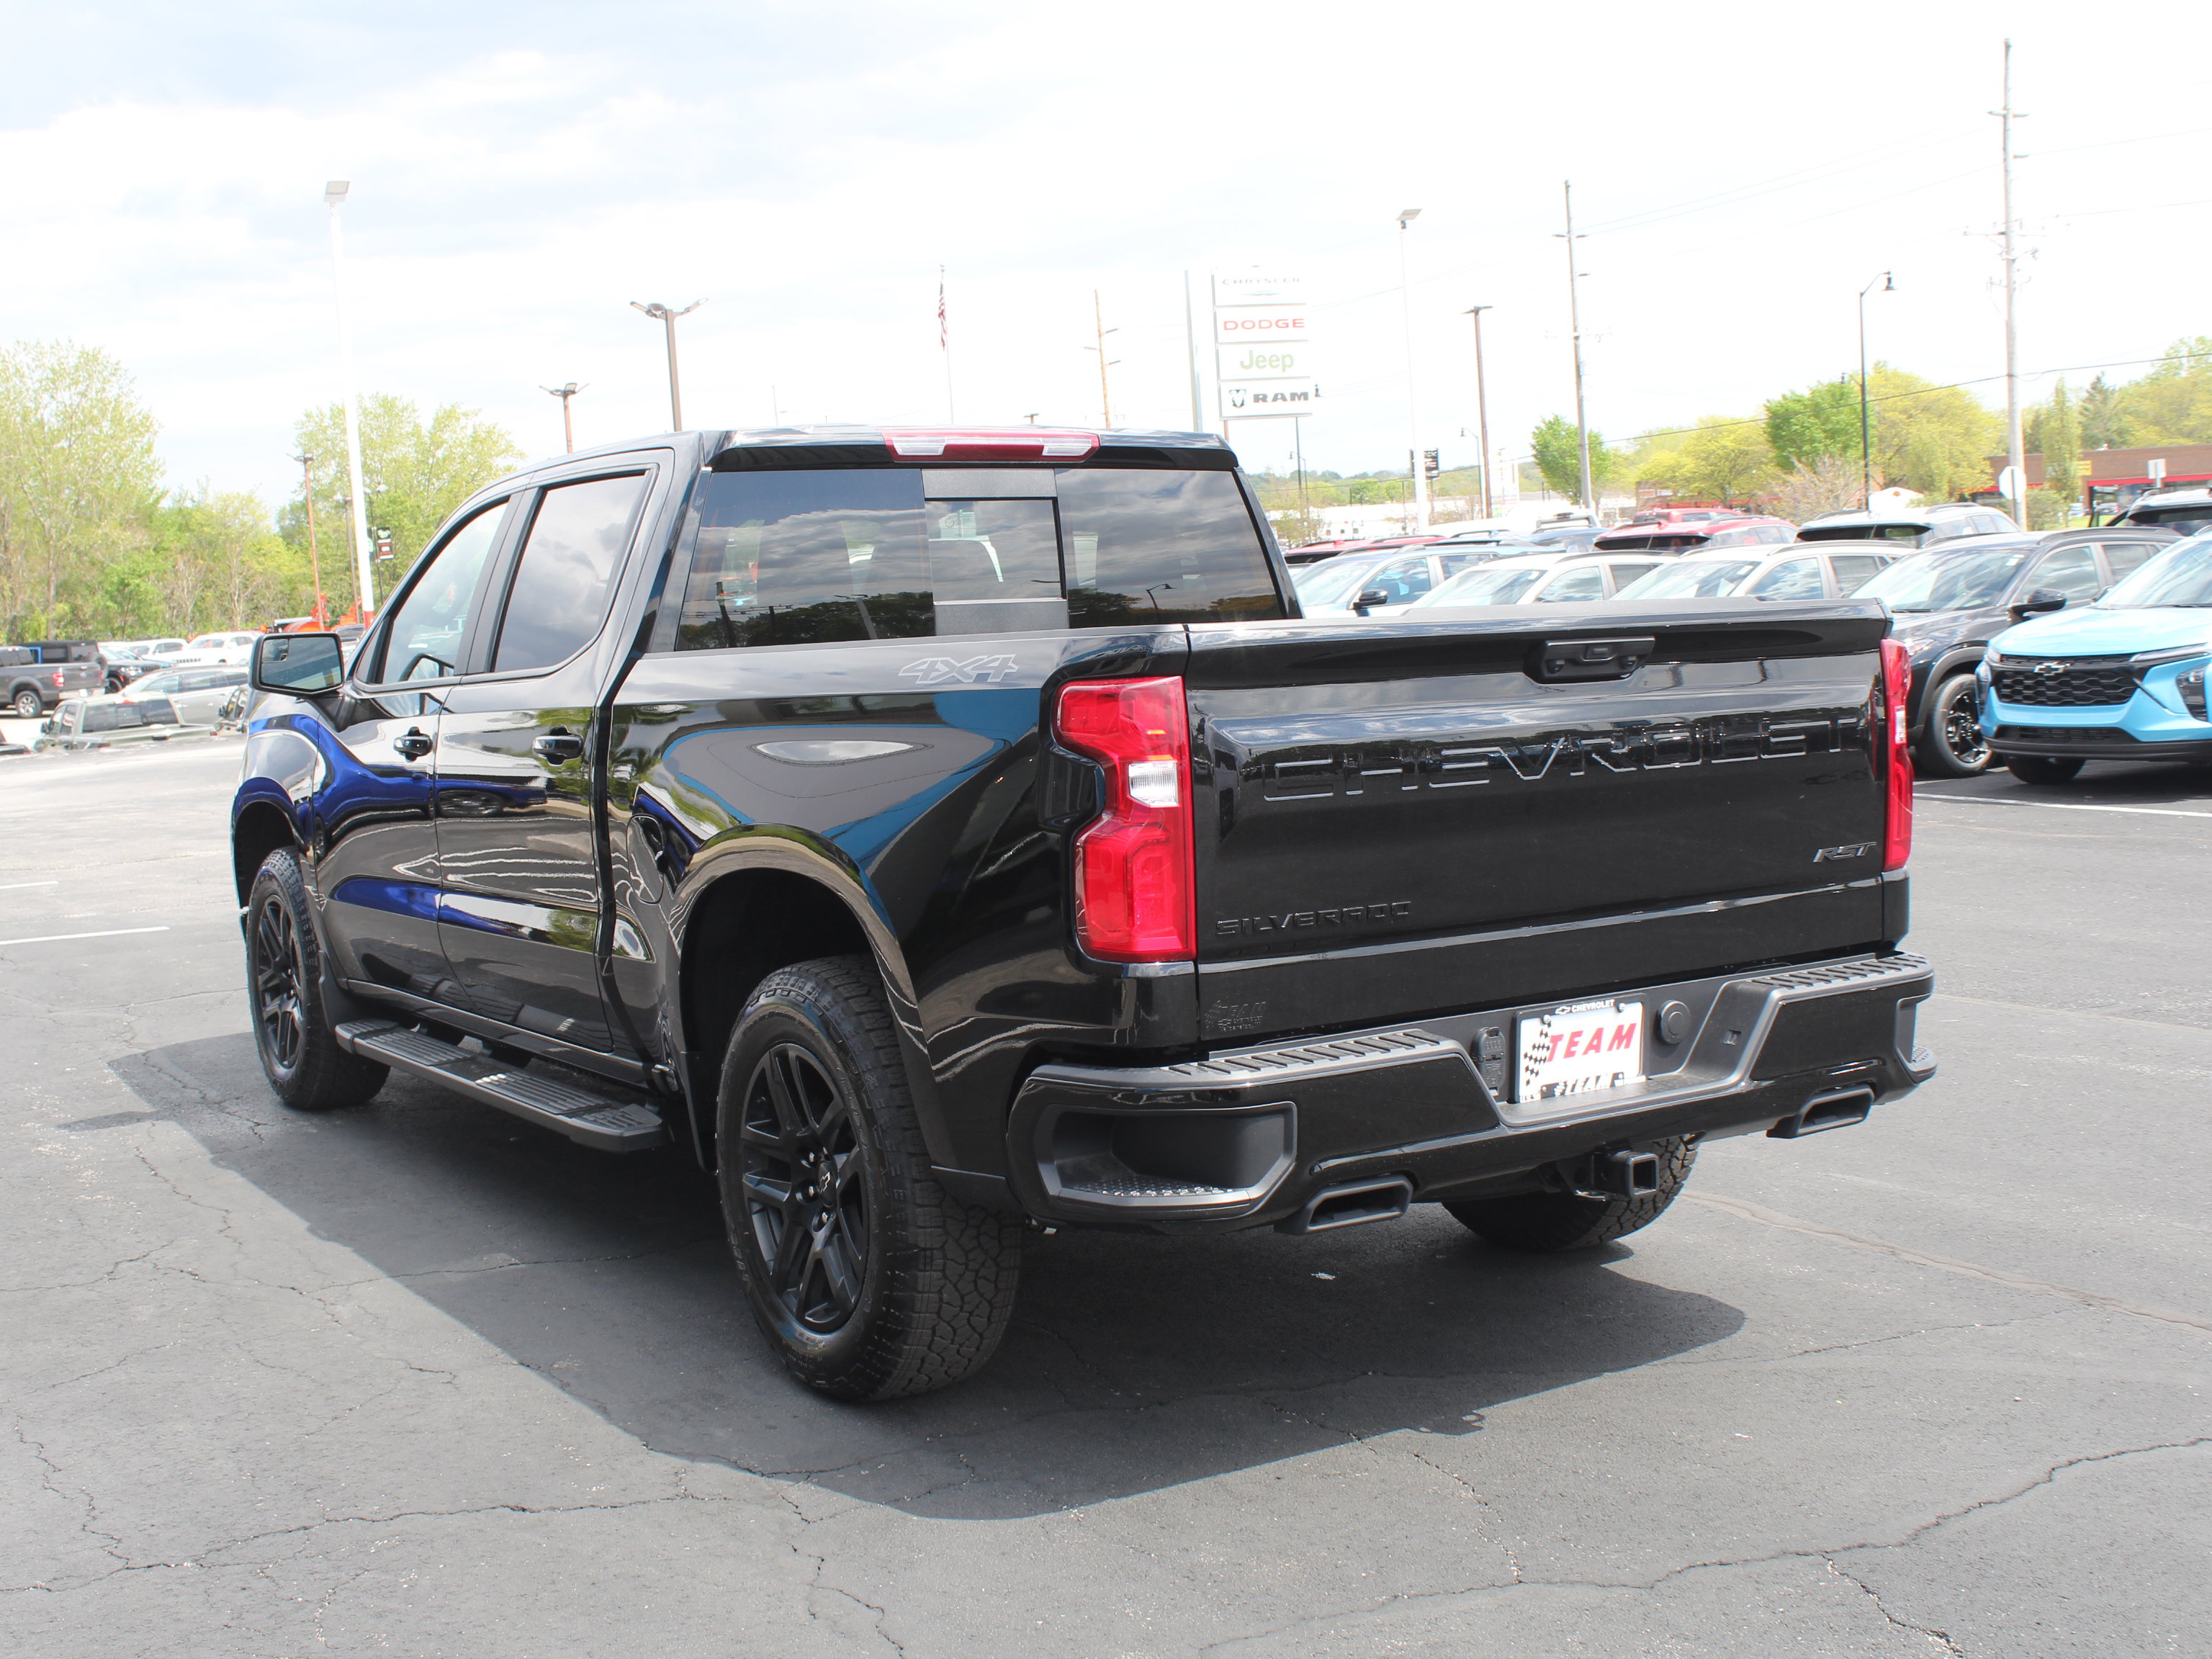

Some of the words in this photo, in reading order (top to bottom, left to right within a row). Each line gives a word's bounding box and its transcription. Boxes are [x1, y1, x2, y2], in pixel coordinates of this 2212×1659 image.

[1223, 318, 1305, 331] DODGE
[1239, 350, 1294, 372] Jeep
[1253, 391, 1309, 403] RAM
[1263, 714, 1865, 802] CHEVROLET
[1812, 841, 1878, 863] RST
[1215, 901, 1411, 935] SILVERADO
[1571, 999, 1615, 1013] CHEVROLET
[1547, 1022, 1637, 1062] TEAM
